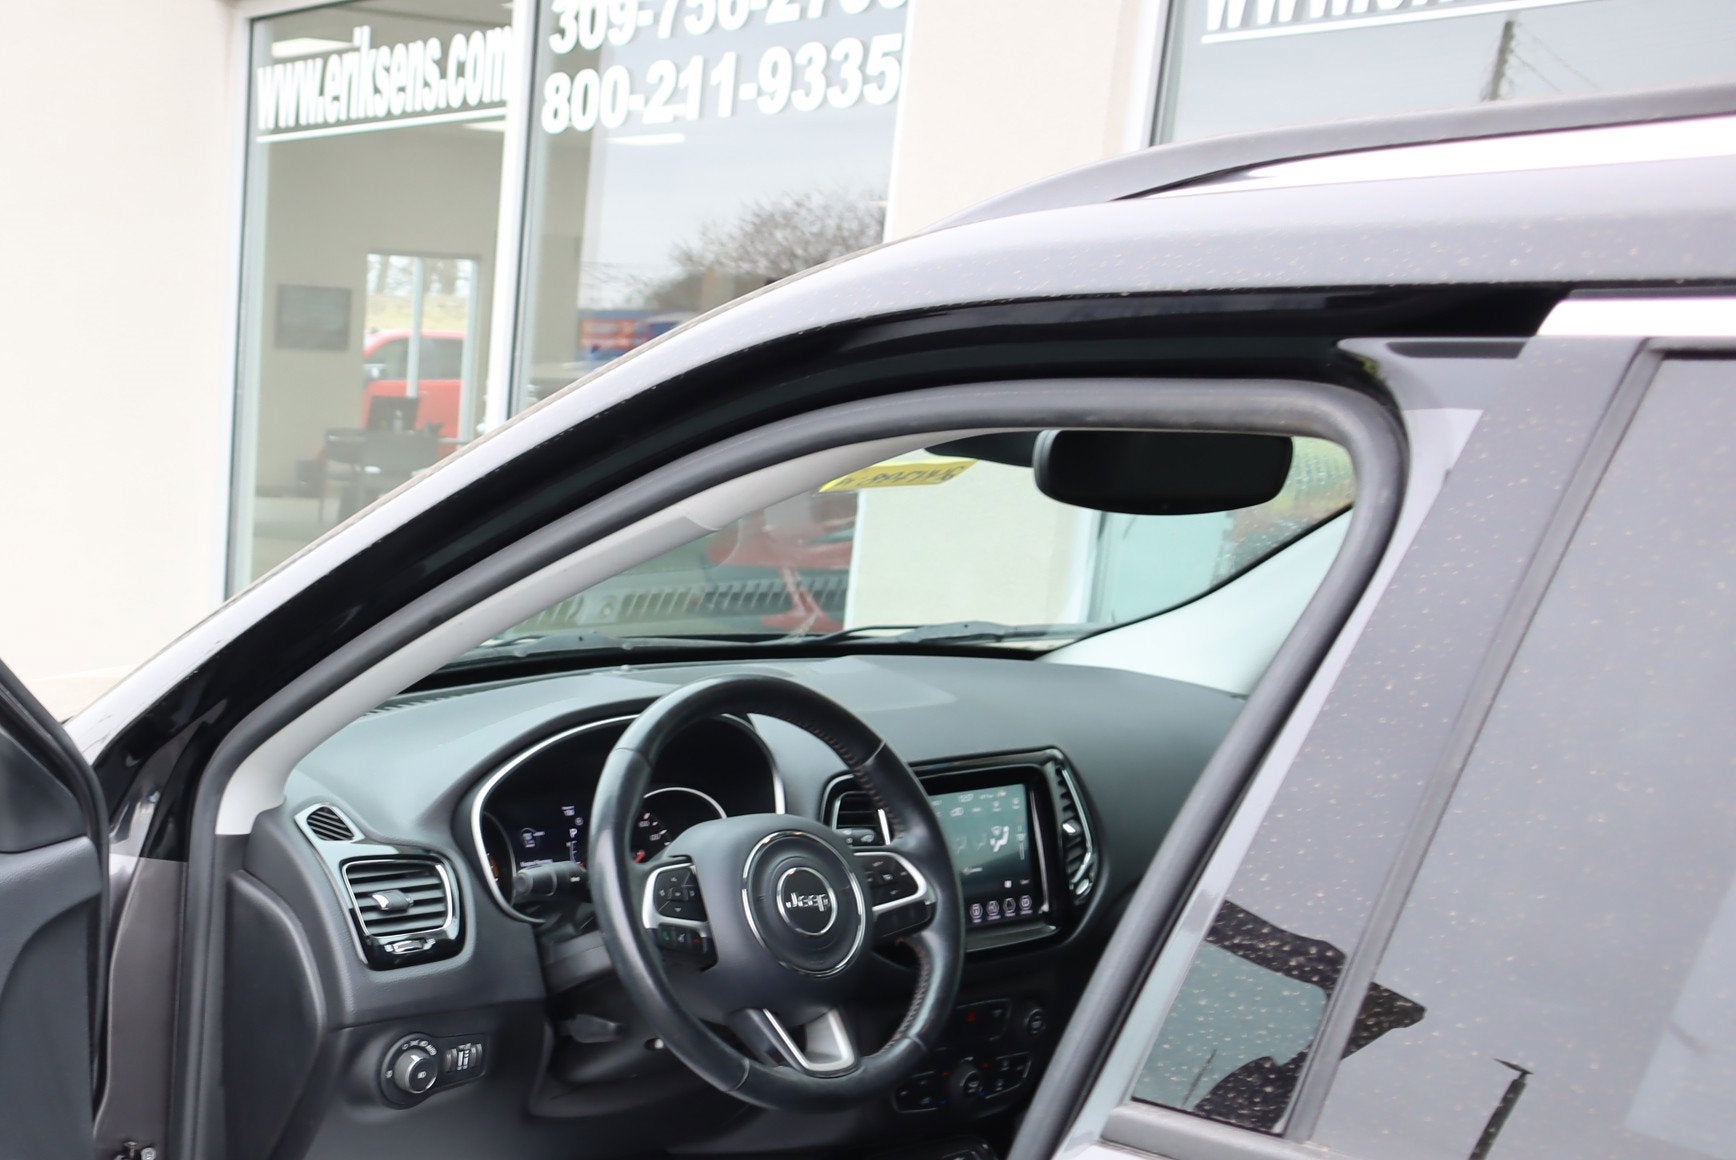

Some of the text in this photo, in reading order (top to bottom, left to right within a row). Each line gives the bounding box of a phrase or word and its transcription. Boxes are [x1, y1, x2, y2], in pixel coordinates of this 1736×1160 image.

[257, 25, 513, 130] www.eriksens.com
[541, 33, 904, 134] 800-211-9335
[785, 892, 830, 912] Jeep
